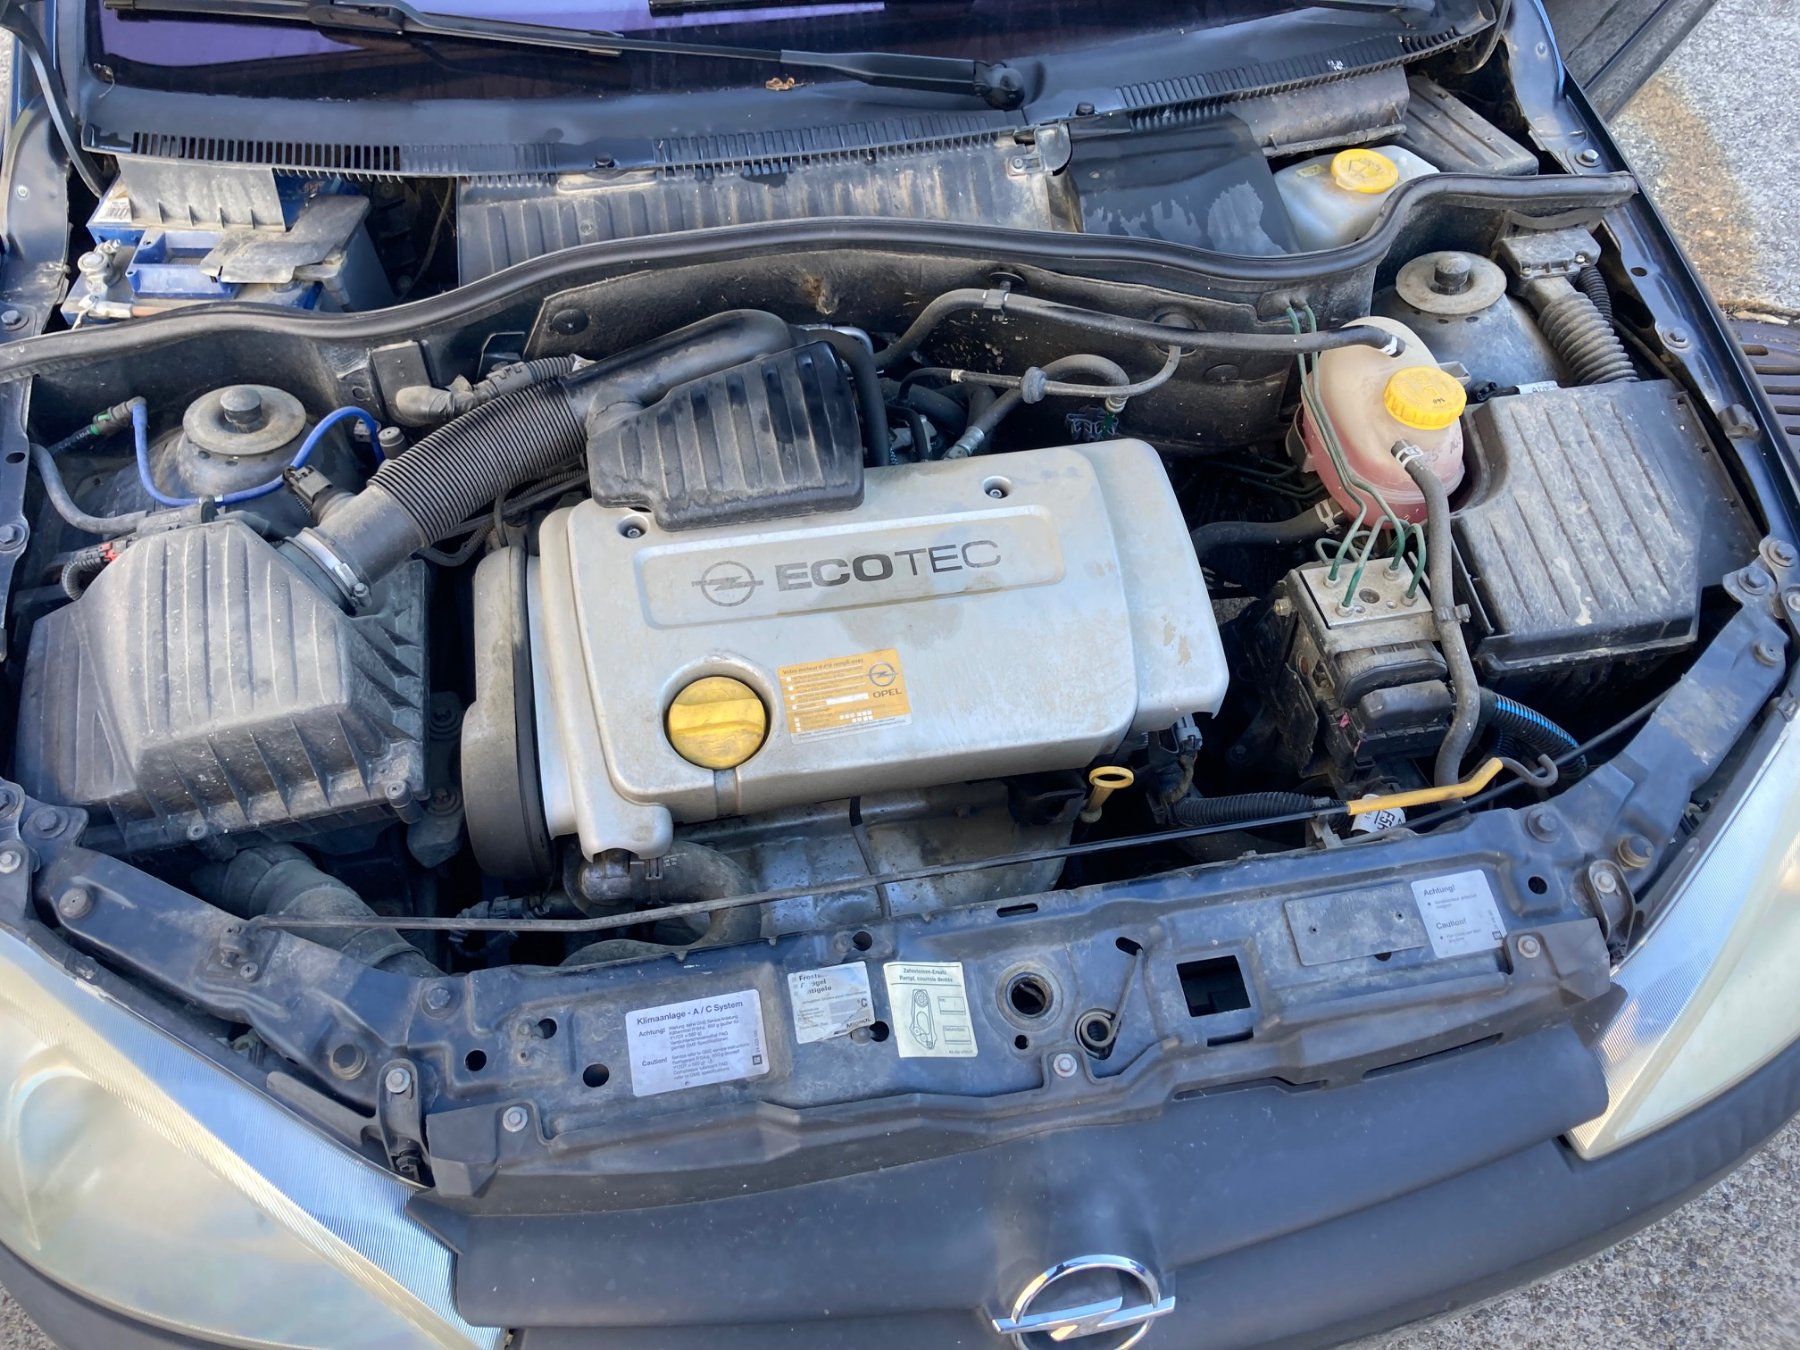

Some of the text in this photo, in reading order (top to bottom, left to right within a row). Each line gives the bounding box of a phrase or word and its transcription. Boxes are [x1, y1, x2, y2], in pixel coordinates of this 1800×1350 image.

[774, 539, 1002, 592] ECOTEC
[873, 688, 902, 698] OPEL
[1424, 884, 1455, 896] Achtung!
[1436, 919, 1466, 930] Caution!
[637, 1011, 686, 1025] Klimaanlage
[705, 1005, 712, 1013] C
[713, 1001, 743, 1012] System
[639, 1027, 666, 1037] Achtung!
[642, 1057, 668, 1067] Caution!
